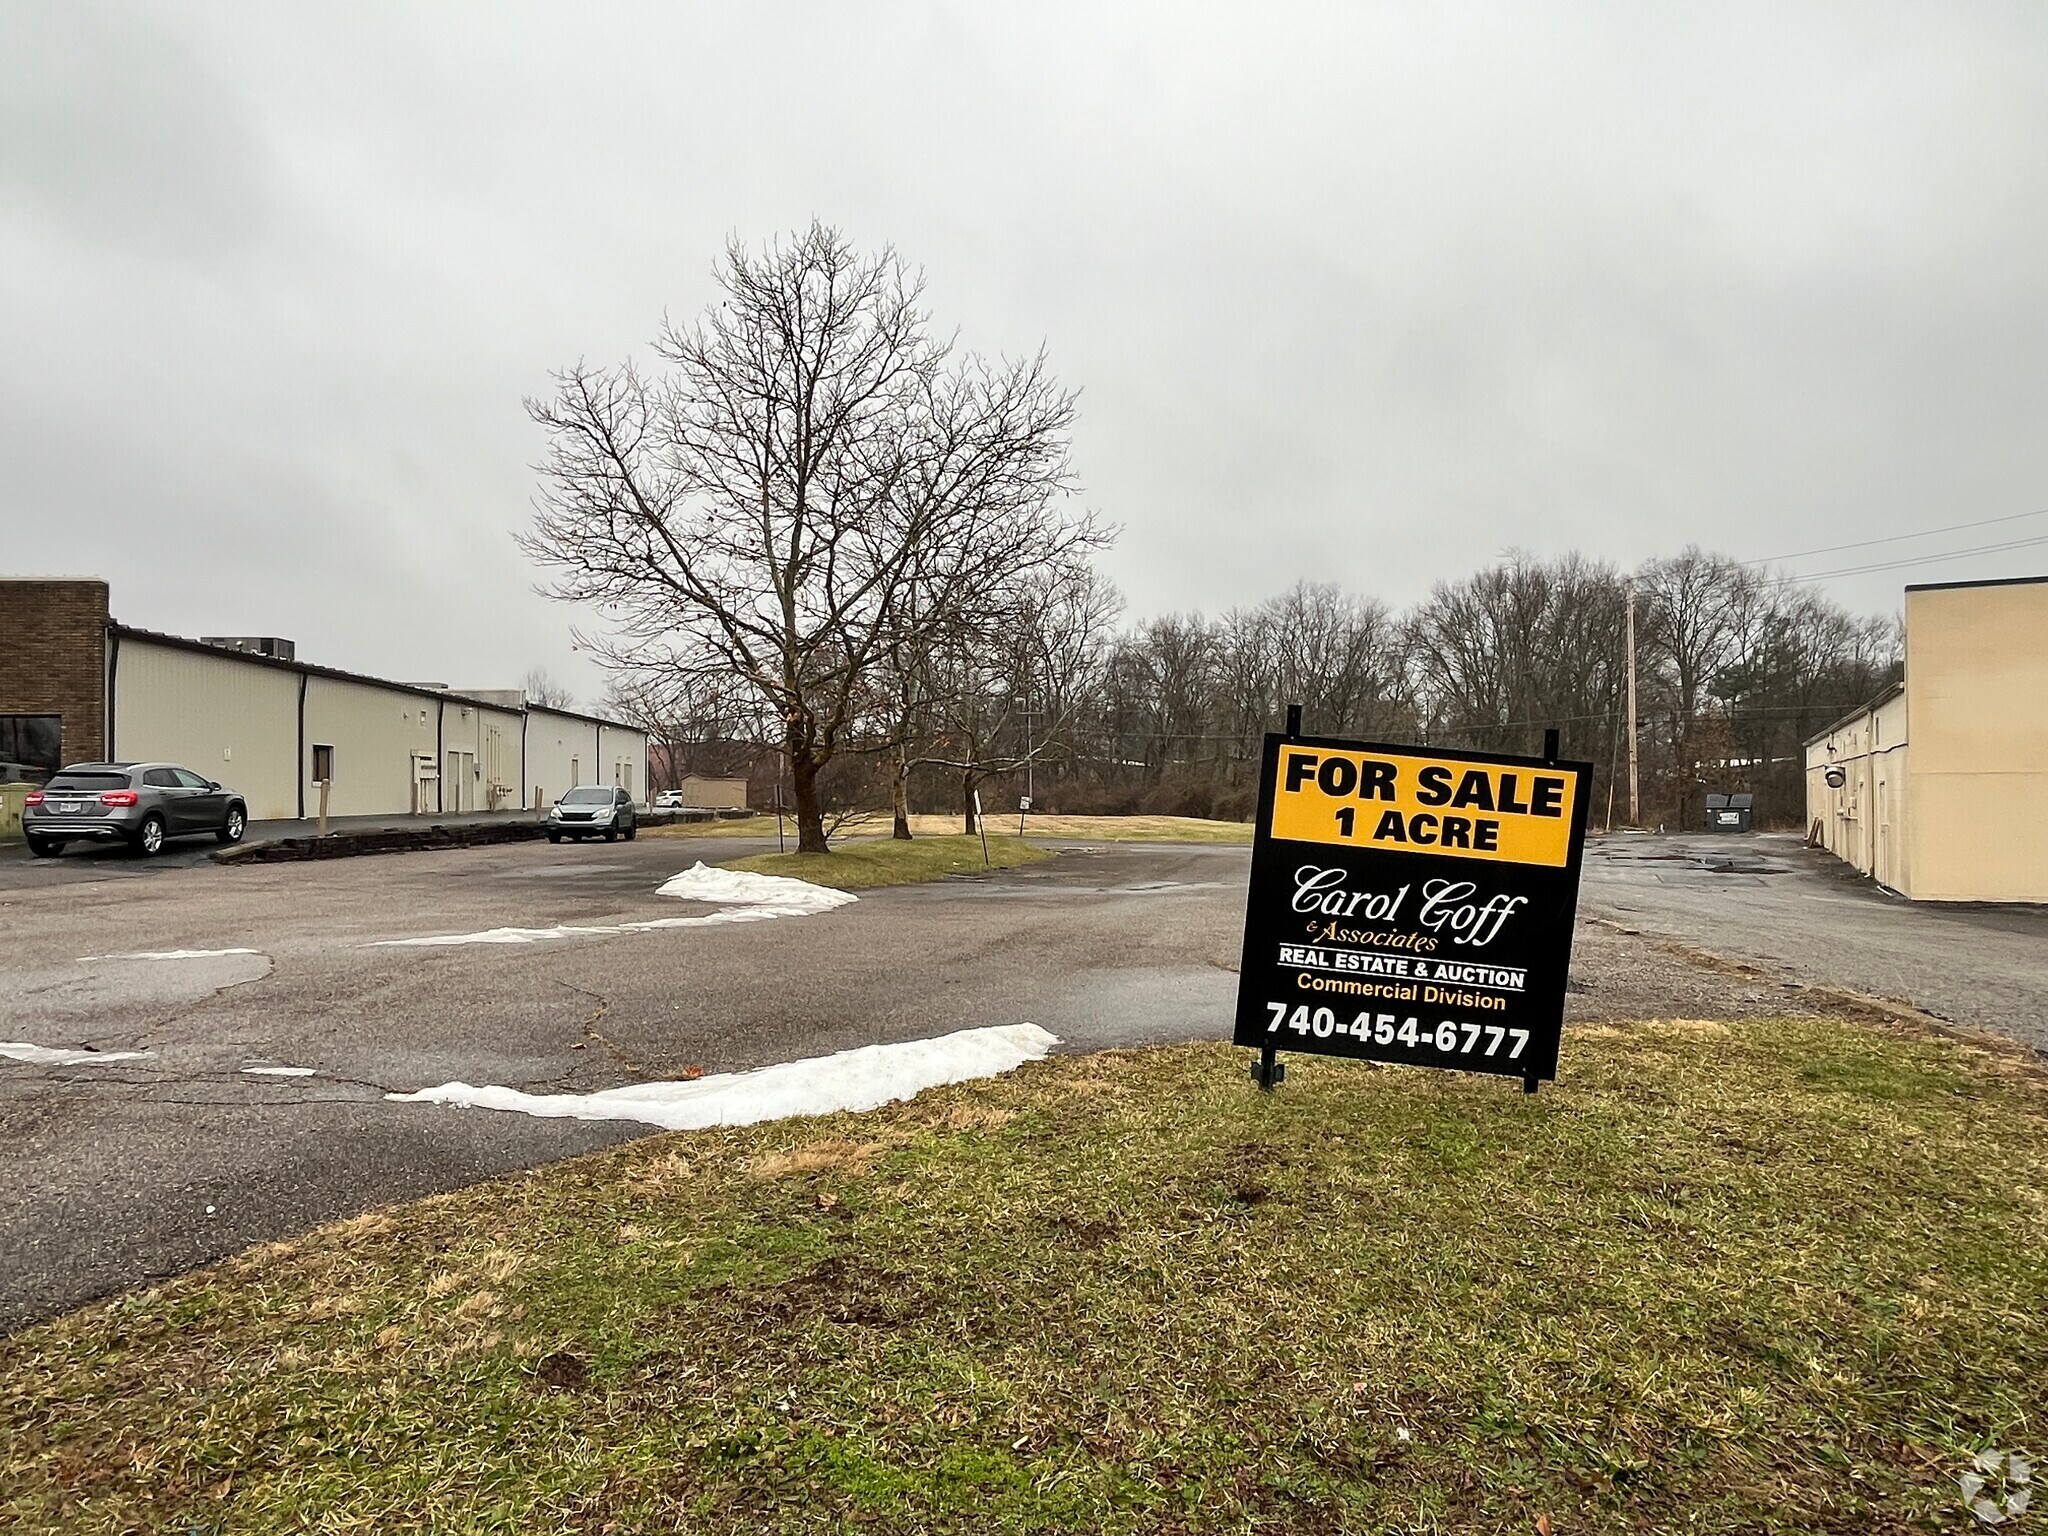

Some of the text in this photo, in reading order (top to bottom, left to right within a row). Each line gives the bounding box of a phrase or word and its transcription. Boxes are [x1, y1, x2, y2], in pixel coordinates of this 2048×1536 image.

[1285, 753, 1565, 818] FOR SALE
[1335, 807, 1499, 851] 1 ACRE
[1292, 865, 1528, 946] Carol Goff
[1307, 921, 1438, 952] & Associates
[1279, 947, 1524, 988] REAL ESTATE & AUCTION
[1297, 972, 1506, 1010] Commercial Division
[1266, 1002, 1529, 1058] 740-454-6777
